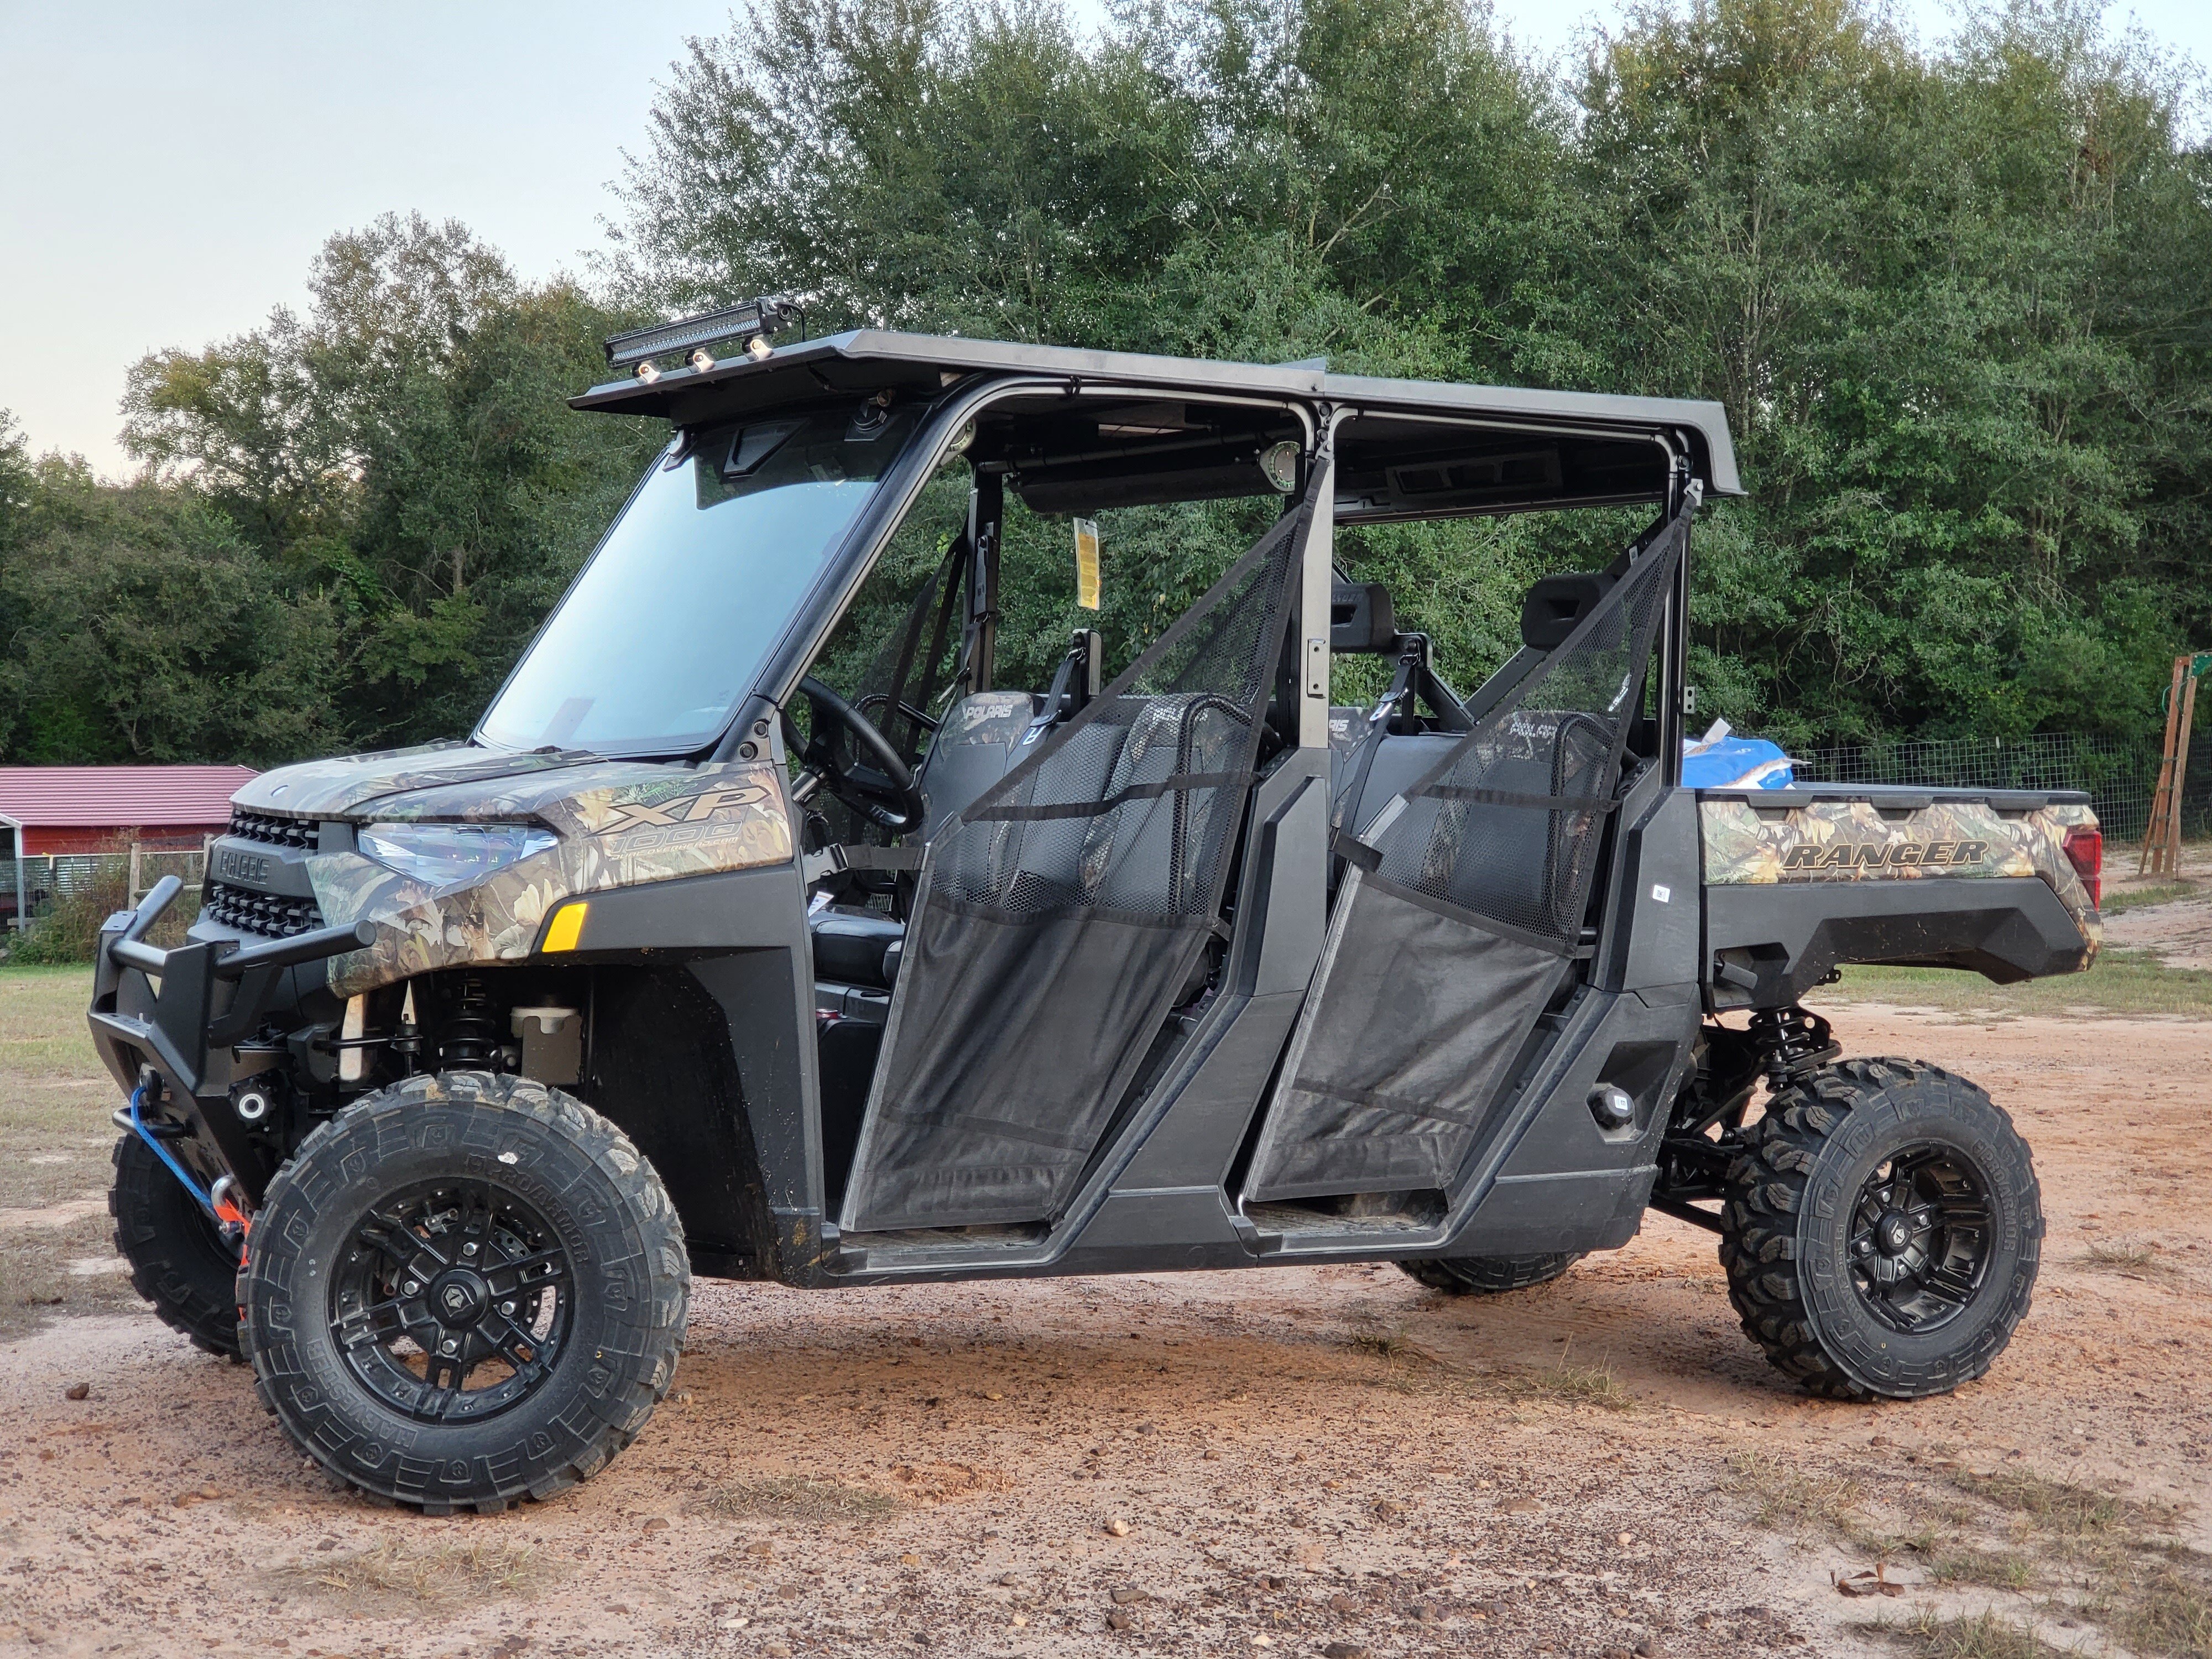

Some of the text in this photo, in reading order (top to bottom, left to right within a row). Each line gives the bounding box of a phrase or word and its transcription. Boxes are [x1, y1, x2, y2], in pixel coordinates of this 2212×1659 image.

[967, 704, 1013, 719] POLARIS
[582, 785, 772, 839] XP
[609, 852, 644, 861] DUAL
[647, 840, 711, 854] OVERHEAD
[610, 820, 743, 854] 1000
[1782, 839, 1991, 870] RANGER
